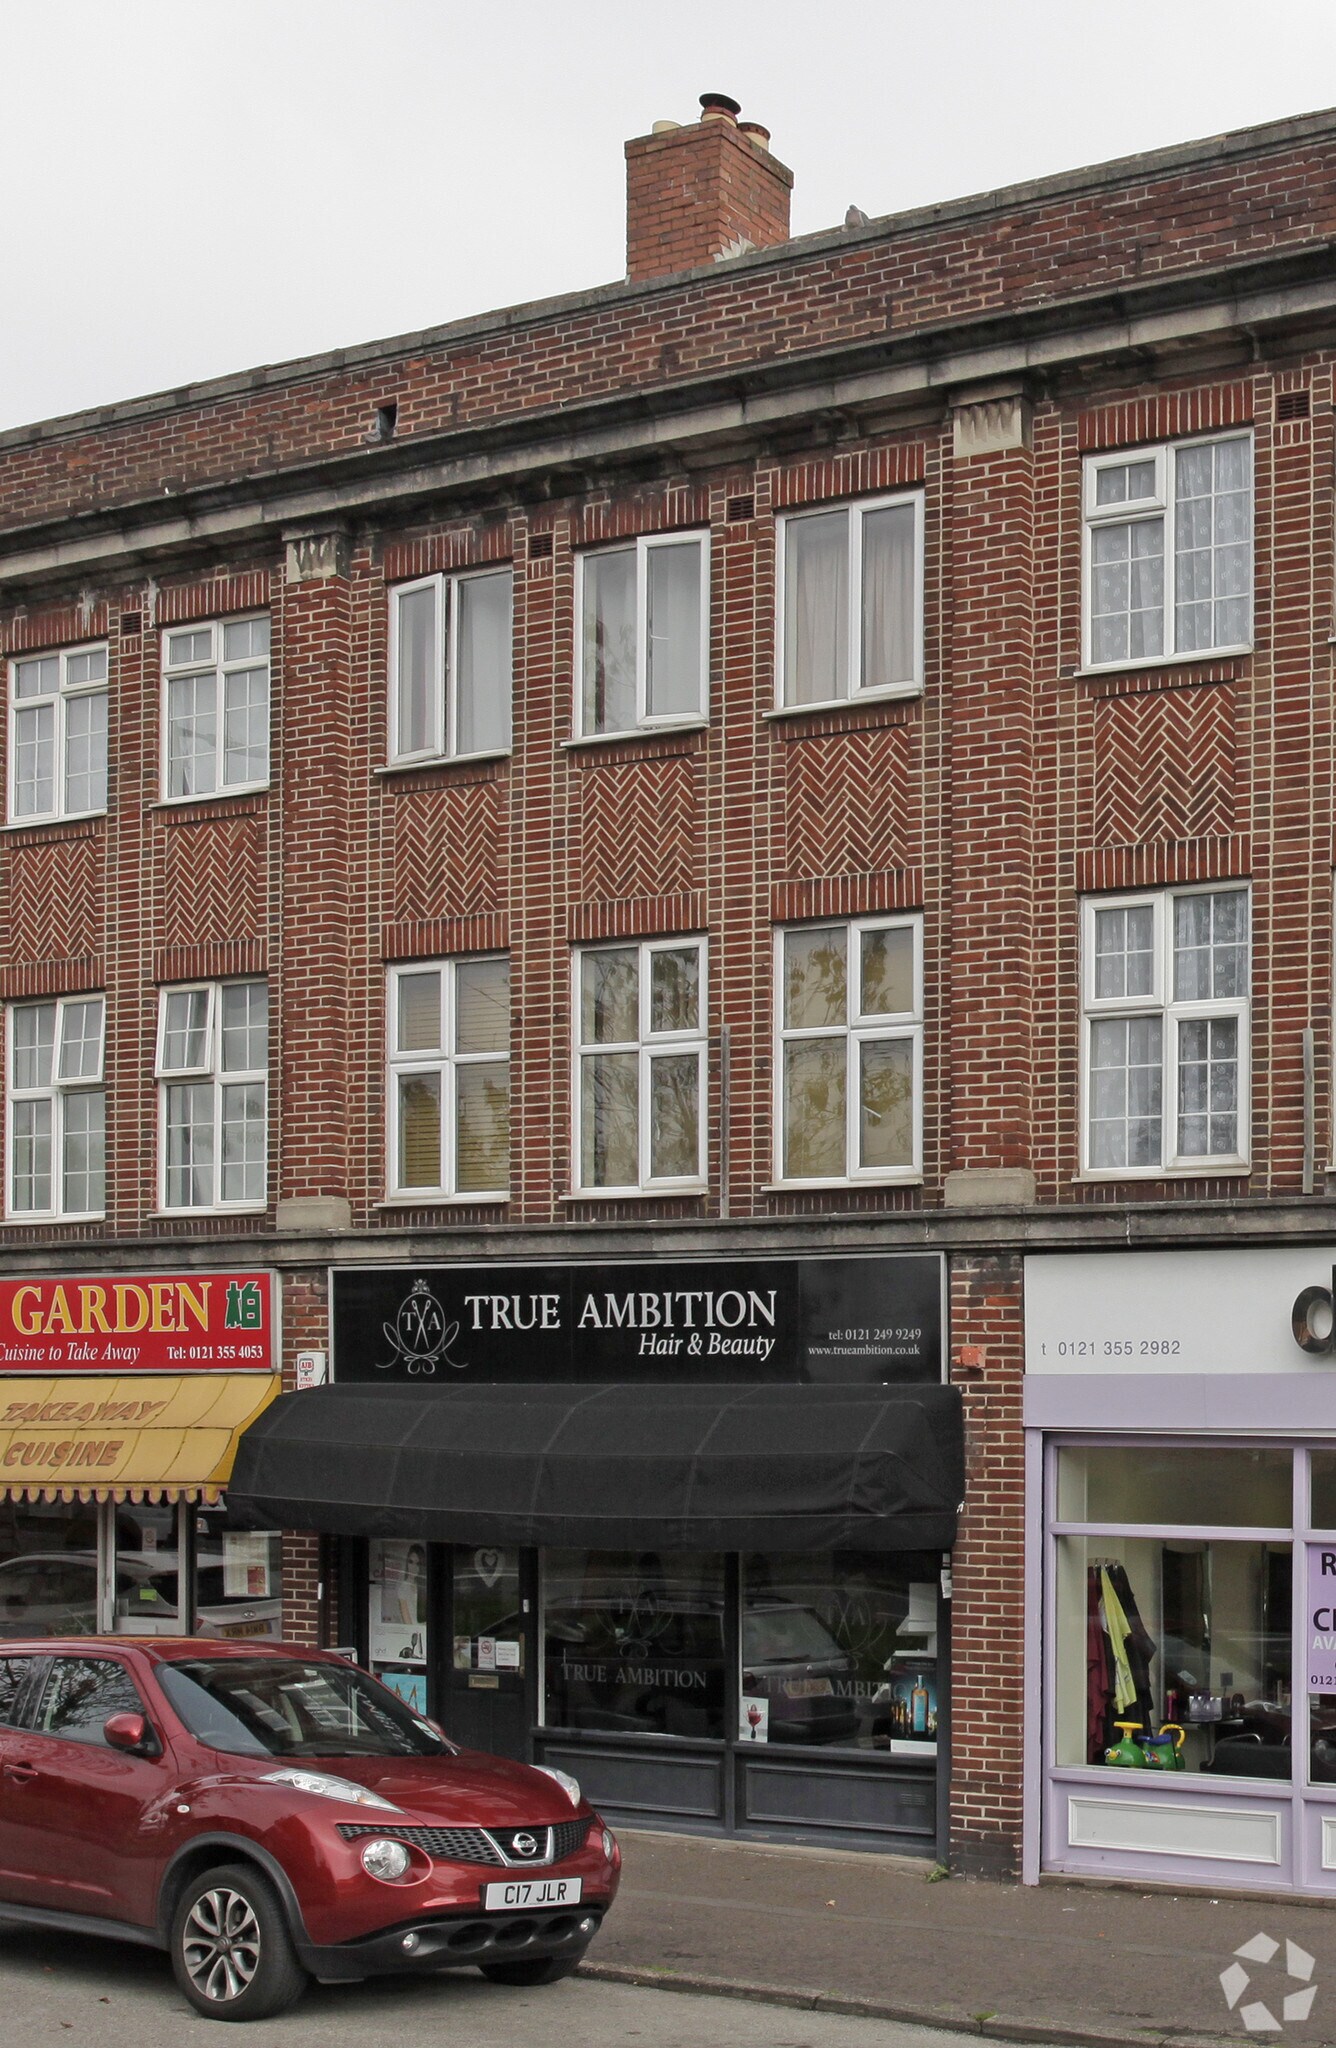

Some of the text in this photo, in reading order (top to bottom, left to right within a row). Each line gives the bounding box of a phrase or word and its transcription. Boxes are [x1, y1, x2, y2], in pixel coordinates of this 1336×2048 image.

[11, 1281, 212, 1336] GARDEN
[464, 1290, 777, 1331] TRUE AMBITION
[828, 1328, 922, 1340] tel: 0121 249 9249
[49, 1345, 62, 1361] to
[66, 1342, 98, 1361] Take
[101, 1342, 140, 1365] Away
[167, 1345, 263, 1360] Tel: 0121 355 4053
[638, 1332, 776, 1361] Hair & Beauty
[808, 1344, 920, 1355] www.trueambition.co.uk
[1041, 1340, 1181, 1356] t 0121 355 2982
[0, 1401, 167, 1422] TAKEAWAY
[3, 1440, 124, 1467] CUISINE
[1313, 1607, 1336, 1632] C
[1312, 1636, 1336, 1650] AV
[561, 1663, 707, 1689] TRUE AMBITION
[824, 1679, 908, 1702] AMBITIO
[504, 1882, 567, 1904] C17 JLR
